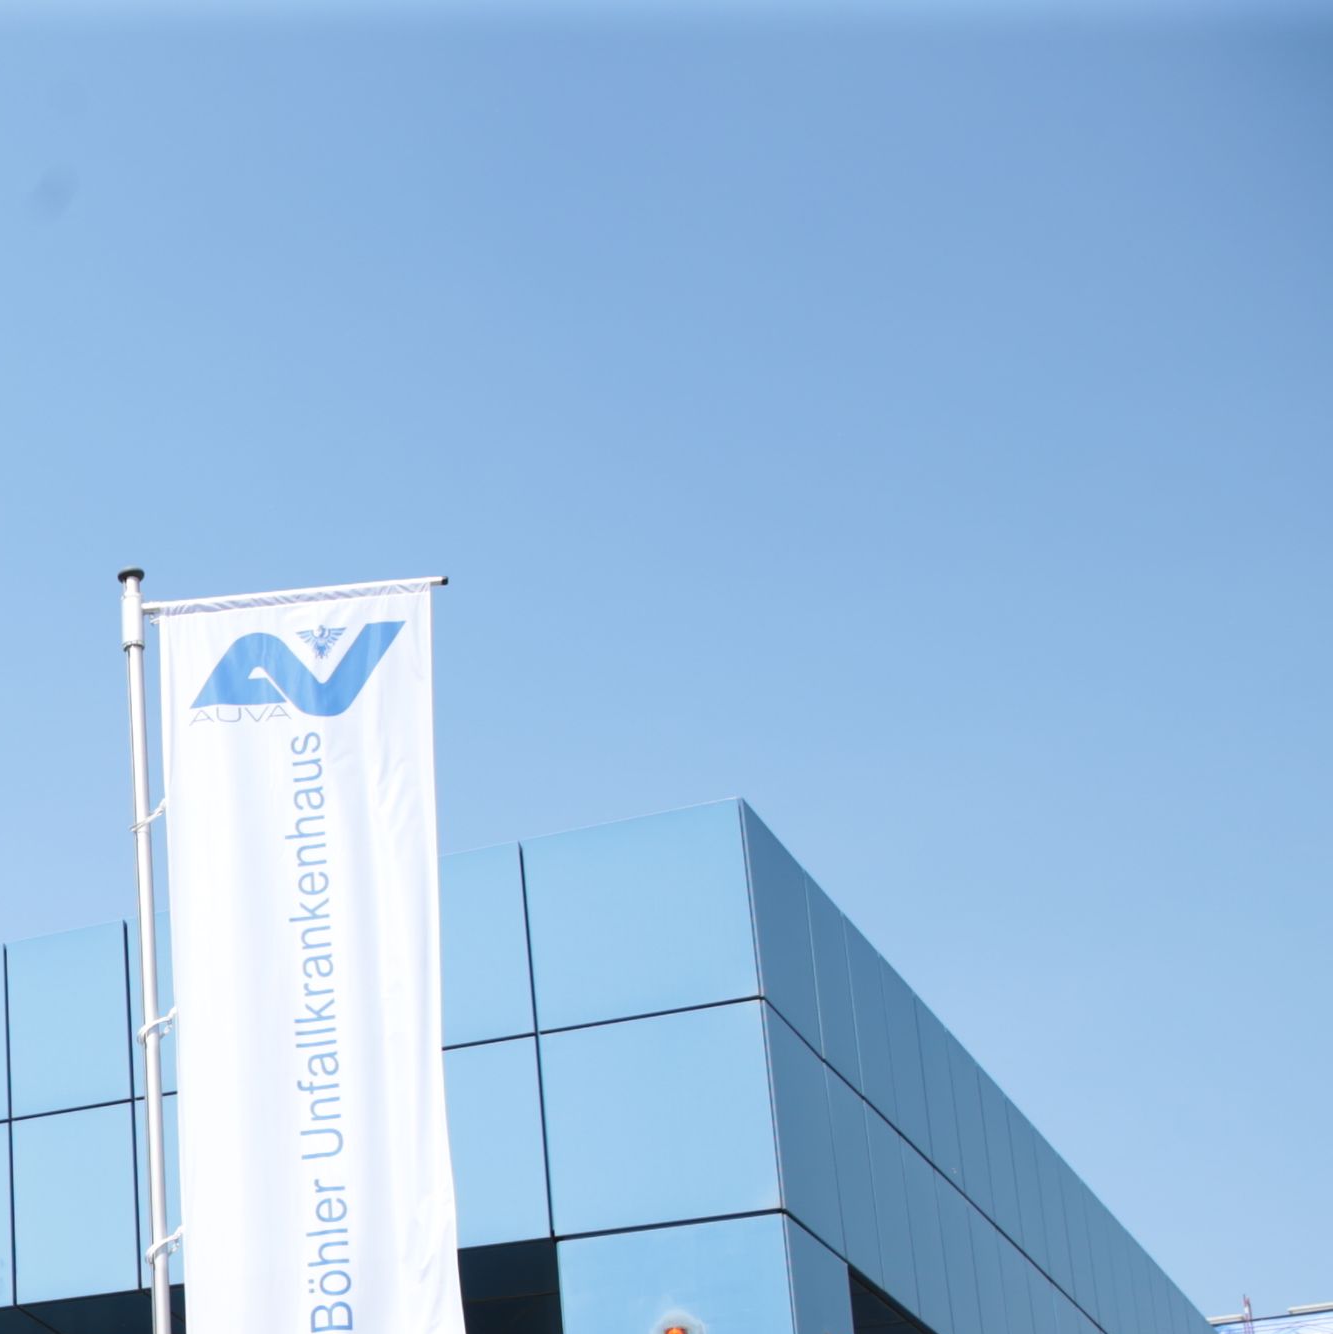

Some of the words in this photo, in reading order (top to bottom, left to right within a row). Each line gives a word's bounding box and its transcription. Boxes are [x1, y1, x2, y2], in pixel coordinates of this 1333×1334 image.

[188, 703, 293, 727] AUVA
[284, 730, 345, 1161] Unfallkrankenhaus
[305, 1178, 354, 1334] Böhler
